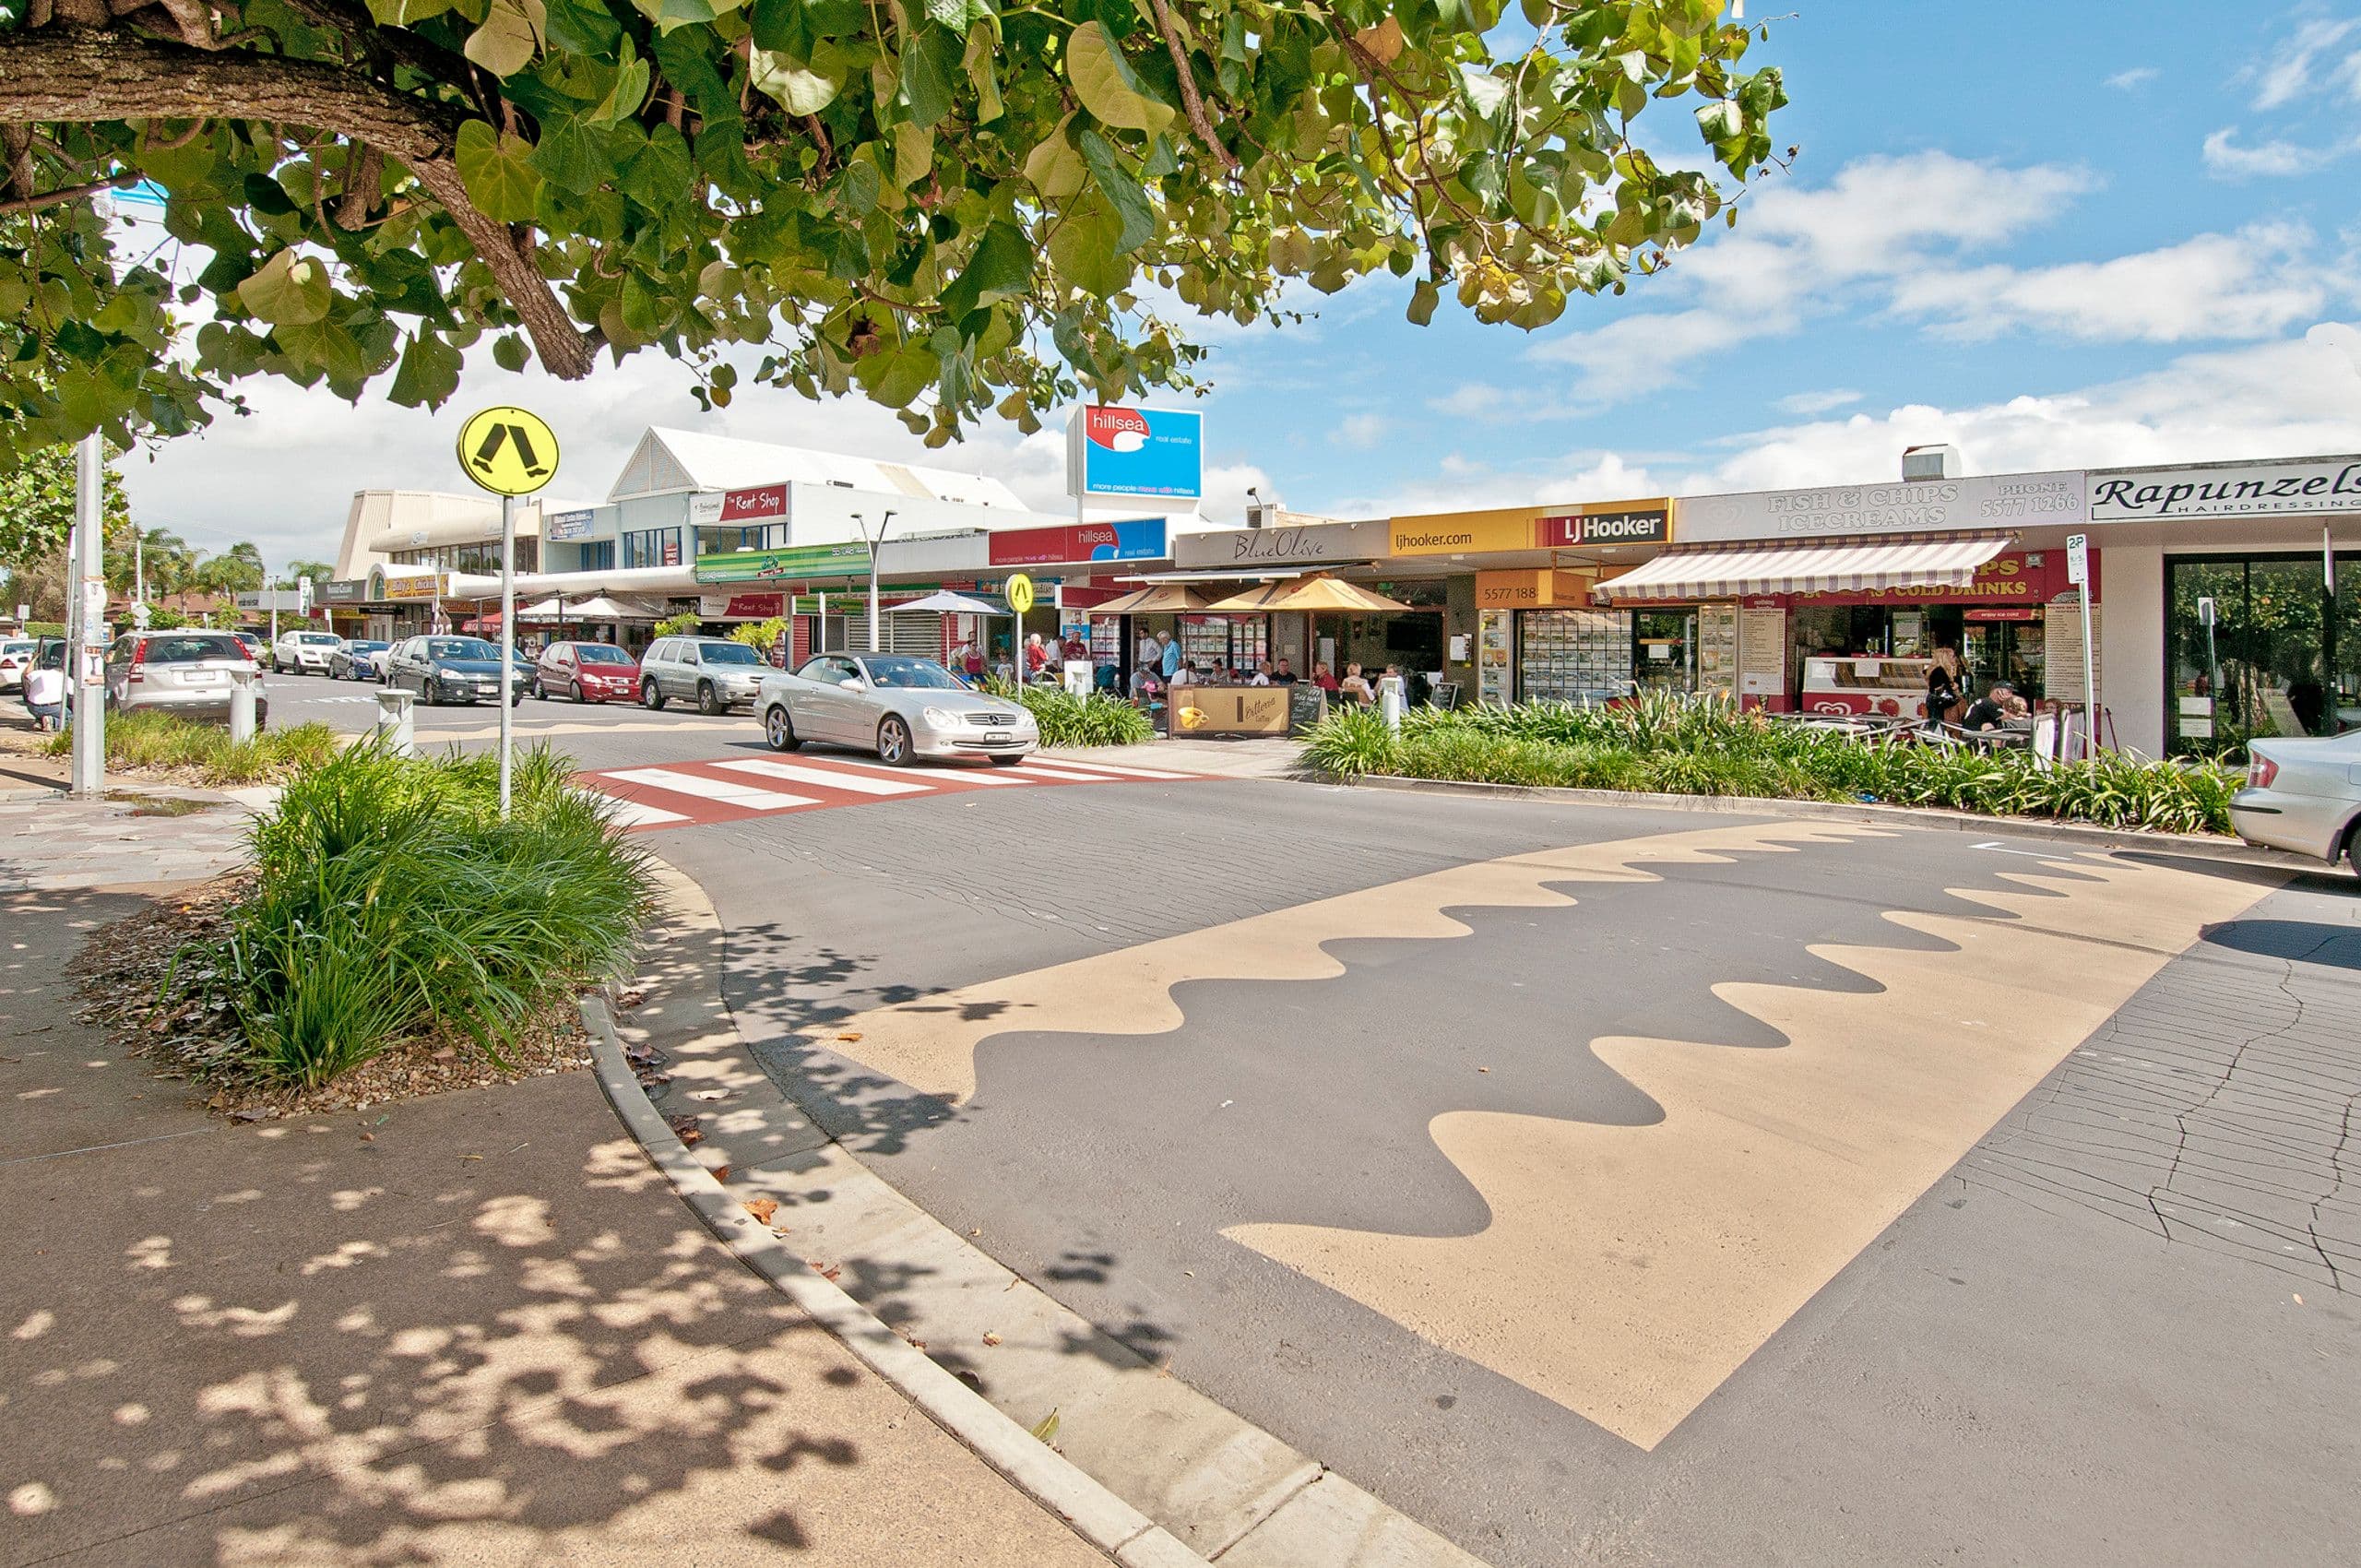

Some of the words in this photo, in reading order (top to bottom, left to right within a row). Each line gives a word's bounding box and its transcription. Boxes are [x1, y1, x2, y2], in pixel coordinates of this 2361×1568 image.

[1093, 414, 1145, 431] hillsea
[1156, 435, 1169, 444] real
[1170, 436, 1192, 445] estate
[1112, 483, 1137, 493] people
[1999, 481, 2067, 495] PHONE
[2093, 464, 2361, 514] Rapunzel
[736, 494, 756, 510] Rent
[759, 493, 779, 514] Shop
[1768, 493, 1831, 513] FISH
[1837, 491, 1860, 507] &
[1868, 484, 1959, 506] CHIPS
[1980, 498, 2025, 517] 5577
[2031, 493, 2079, 512] 1266
[1778, 507, 1947, 532] ICECREAMS
[1078, 530, 1112, 543] hillsea
[1565, 518, 1580, 543] LJ
[1584, 516, 1661, 538] Hooker
[1395, 533, 1472, 551] ljhooker.com
[2069, 536, 2084, 550] 2P
[1485, 588, 1512, 600] 5577
[1515, 587, 1538, 599] 188
[1949, 581, 2026, 596] DRINKS
